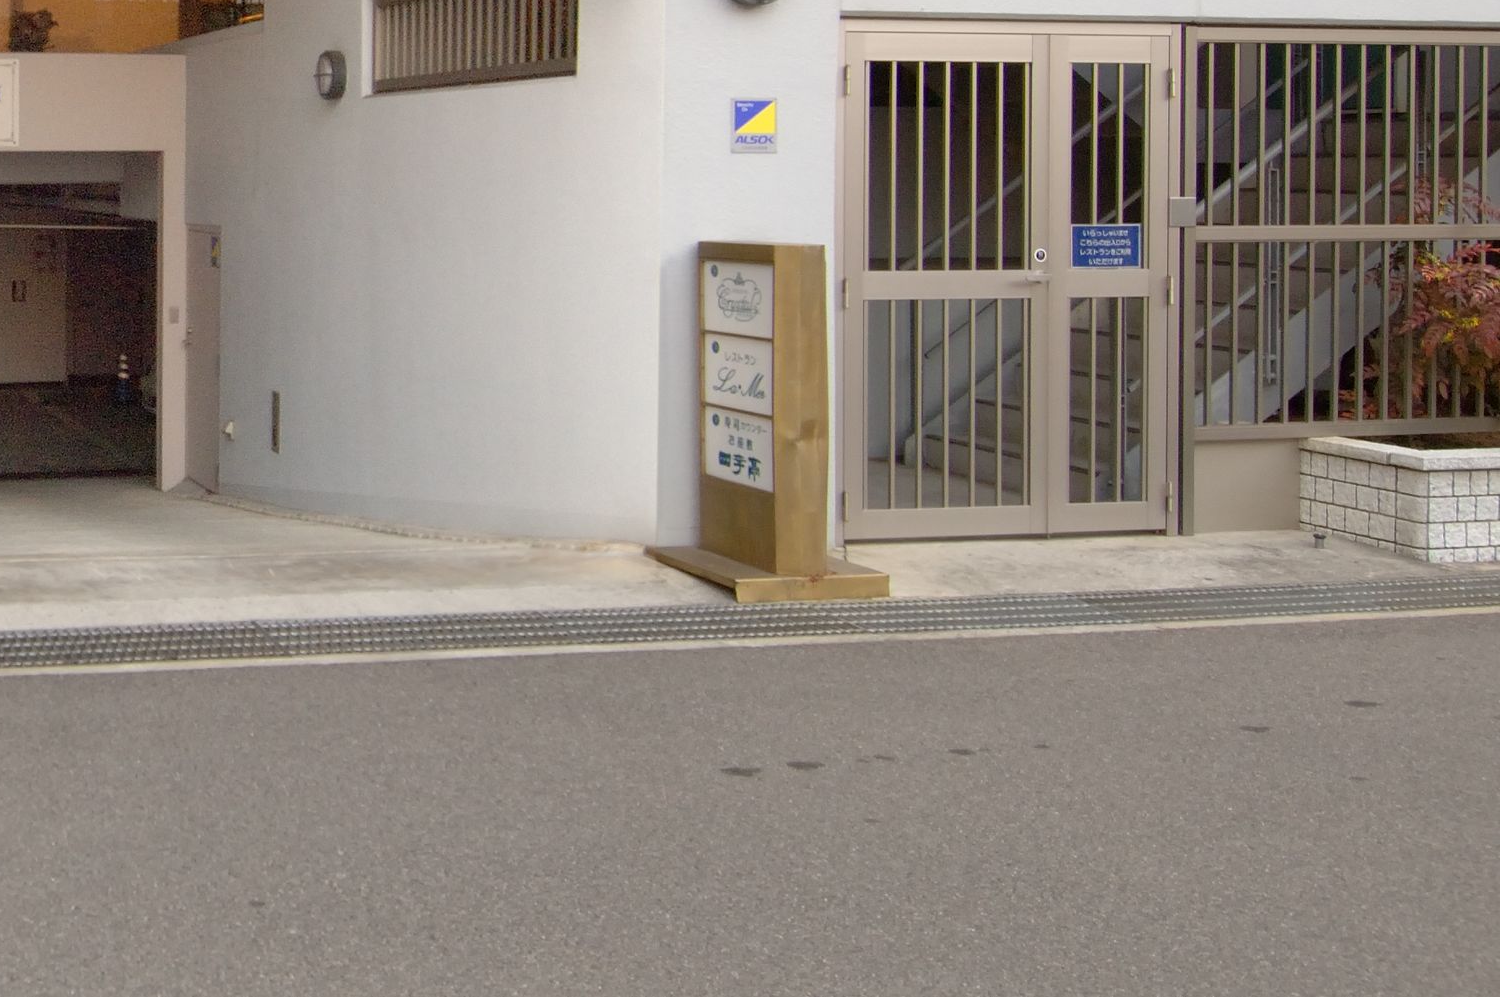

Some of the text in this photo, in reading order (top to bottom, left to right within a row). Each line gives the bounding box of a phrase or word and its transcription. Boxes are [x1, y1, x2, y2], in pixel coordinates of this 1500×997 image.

[735, 135, 774, 145] ALSOK
[724, 351, 756, 365] レストラン
